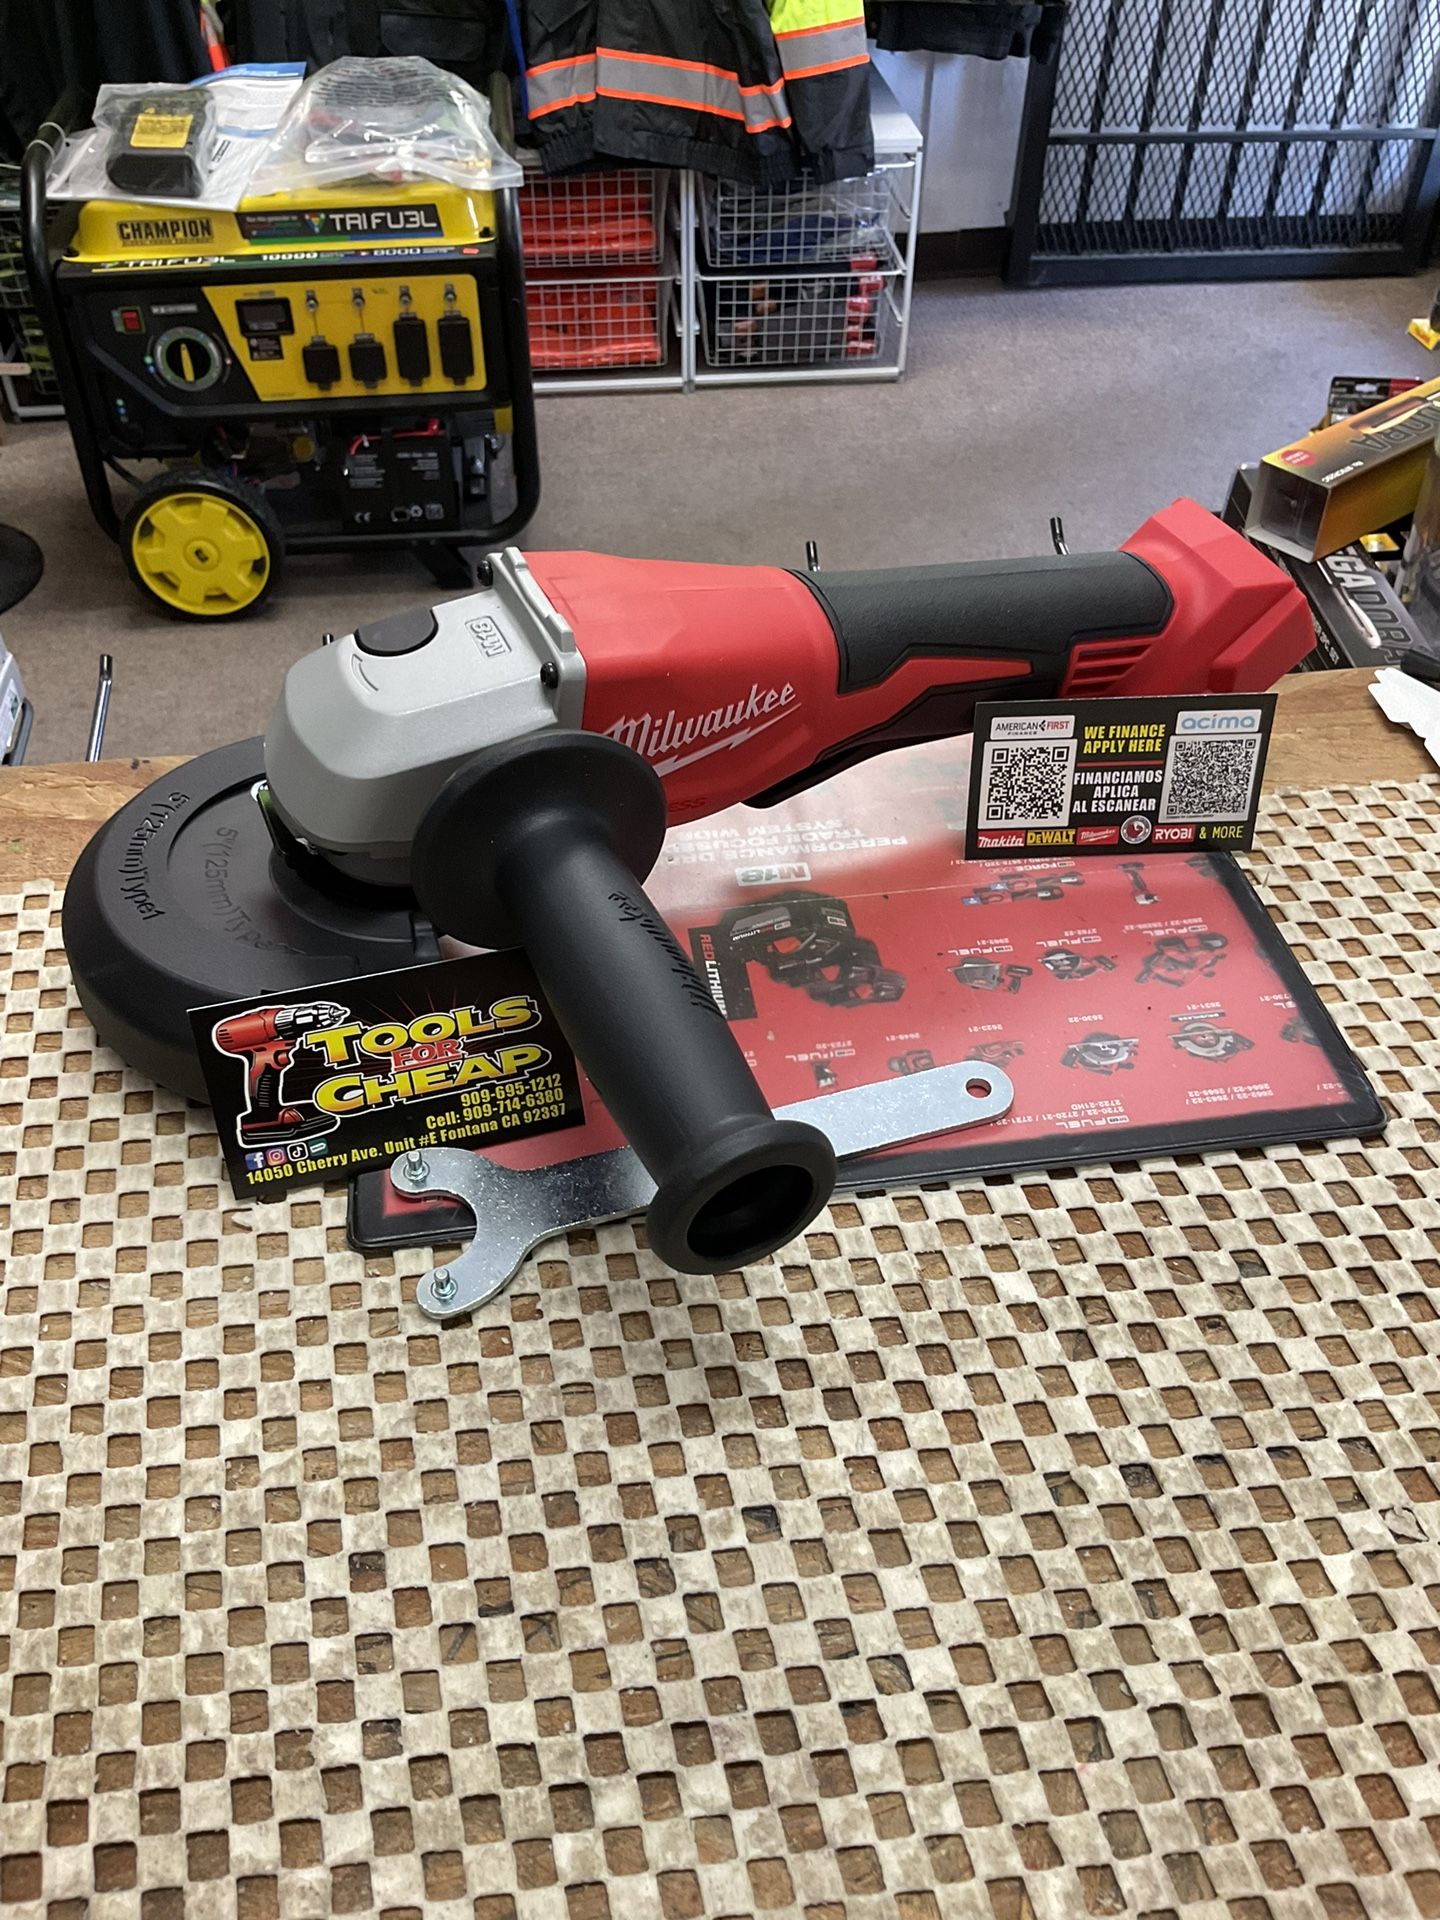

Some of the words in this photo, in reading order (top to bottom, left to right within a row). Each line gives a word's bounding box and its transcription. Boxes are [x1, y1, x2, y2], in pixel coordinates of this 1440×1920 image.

[118, 218, 213, 241] CHAMPION
[469, 622, 507, 658] M18
[601, 681, 796, 758] Milwaukee
[995, 721, 1039, 731] AMERICAN
[1046, 720, 1070, 730] FIRST
[1181, 714, 1256, 730] acima
[1084, 725, 1105, 740] WE
[1108, 724, 1166, 739] FINANCE
[1083, 740, 1127, 754] APPLY
[1130, 739, 1162, 752] HERE
[1073, 770, 1163, 785] FINANCIAMOS
[1093, 785, 1139, 799] APLICA
[1072, 800, 1088, 813] AL
[1091, 798, 1156, 813] ESCANEAR
[1155, 828, 1193, 840] RYOBI
[1199, 826, 1207, 839] &
[1211, 825, 1244, 839] MORE
[724, 836, 908, 859] PERFORMANCE
[739, 865, 808, 884] M18
[1142, 927, 1188, 936] FUEL
[1036, 938, 1081, 947] FUEL
[947, 947, 993, 956] FUEL
[1259, 993, 1289, 1002] 730-21
[305, 998, 536, 1064] TOOLS
[390, 1039, 462, 1070] FOR
[785, 1052, 833, 1062] FUEL
[314, 1045, 542, 1113] CHEAP
[460, 1072, 562, 1107] 909-695-1212
[425, 1110, 461, 1130] Cell:
[463, 1087, 565, 1121] 909-714-6380
[1042, 1111, 1079, 1121] 2720-21
[1086, 1106, 1124, 1116] 2720-22
[1056, 1118, 1107, 1129] FUEL
[246, 1162, 294, 1186] 14050
[296, 1151, 348, 1176] Cherry
[350, 1145, 383, 1163] Ave.
[384, 1135, 416, 1155] Unit
[418, 1131, 438, 1148] #E
[440, 1119, 499, 1143] Fontana
[501, 1113, 521, 1131] CA
[523, 1102, 567, 1125] 92337
